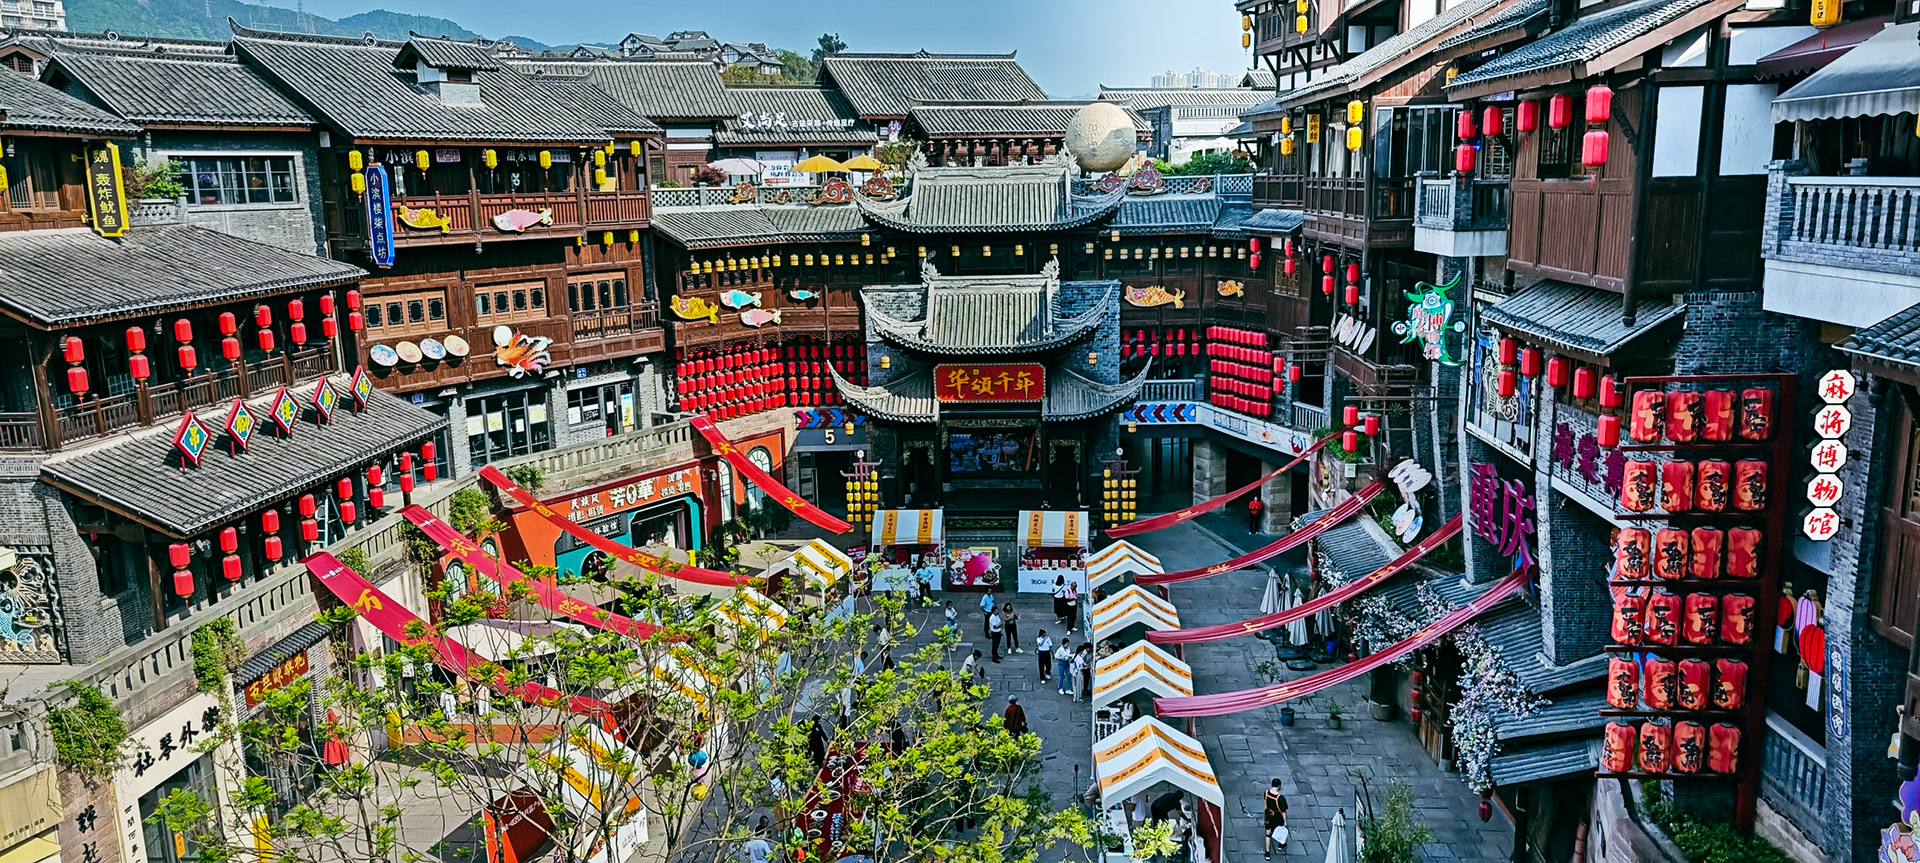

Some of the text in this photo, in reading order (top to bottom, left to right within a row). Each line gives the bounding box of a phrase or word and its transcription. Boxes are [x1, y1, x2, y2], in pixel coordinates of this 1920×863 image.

[92, 149, 119, 228] 魏·轰炸鱿鱼
[369, 172, 386, 259] 小滨楼柒点坊
[824, 429, 835, 445] 5
[1808, 373, 1850, 536] 麻将博物馆
[1470, 462, 1536, 578] 重庆
